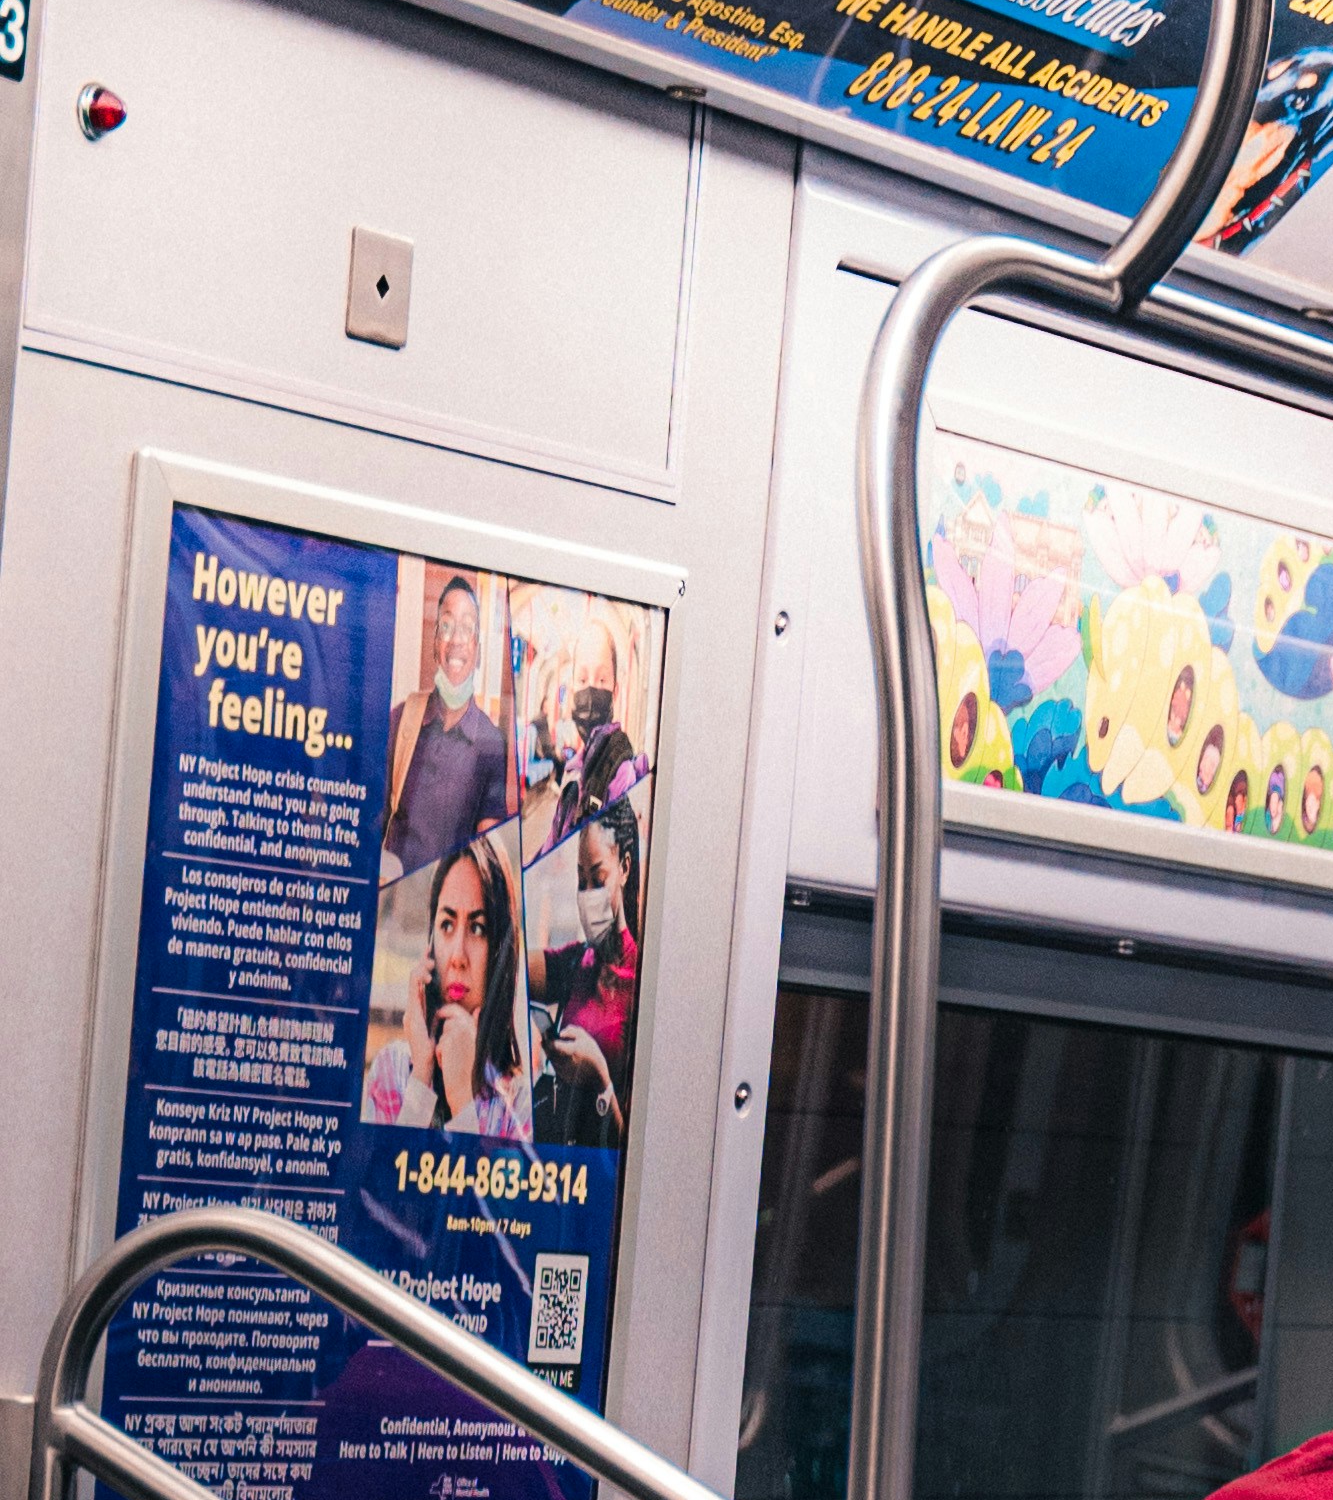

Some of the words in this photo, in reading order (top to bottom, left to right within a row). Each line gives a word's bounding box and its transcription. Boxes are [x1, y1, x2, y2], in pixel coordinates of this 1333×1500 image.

[665, 10, 686, 31] &
[768, 20, 806, 51] Esq.
[880, 1, 994, 62] HANDLE
[979, 41, 1037, 81] ALL
[1028, 58, 1171, 128] ACCIDENTS
[193, 551, 344, 626] However
[193, 623, 303, 681] you're
[208, 677, 353, 758] feeling...
[179, 753, 197, 774] NY
[199, 756, 240, 783] Project
[242, 763, 273, 788] Hope
[275, 769, 305, 791] crisis
[307, 776, 366, 800] counselors
[183, 780, 251, 806] understand
[253, 789, 284, 811] what
[285, 798, 307, 816] you
[309, 801, 328, 817] are
[329, 802, 360, 826] going
[179, 801, 229, 830] through.
[232, 809, 275, 837] Talking
[276, 818, 290, 835] to
[292, 818, 321, 840] them
[323, 823, 332, 842] is
[334, 824, 360, 848] free,
[184, 829, 258, 856] confidential,
[260, 839, 283, 858] and
[284, 843, 352, 868] anonymous.
[182, 865, 203, 886] Los
[204, 869, 267, 895] consejeros
[269, 877, 284, 896] de
[285, 880, 315, 900] crisis
[317, 883, 331, 902] de
[333, 885, 350, 905] NY
[164, 886, 207, 913] Project
[209, 893, 240, 917] Hope
[242, 898, 300, 922] entienden
[302, 904, 313, 924] lo
[315, 909, 336, 930] que
[338, 910, 362, 930] está
[171, 913, 225, 936] viviendo.
[227, 919, 263, 941] Puede
[265, 923, 302, 946] hablar
[304, 934, 324, 949] con
[326, 932, 353, 952] ellos
[167, 935, 183, 955] de
[185, 940, 231, 961] manera
[232, 946, 283, 968] gratuita,
[285, 951, 353, 975] confidencial
[228, 969, 237, 990] y
[238, 968, 292, 991] anónima.
[156, 1098, 206, 1123] Konseye
[208, 1103, 231, 1122] Kriz
[233, 1106, 250, 1123] NY
[252, 1106, 292, 1130] Project
[294, 1110, 323, 1133] Hope
[325, 1115, 339, 1134] yo
[149, 1120, 207, 1146] konprann
[209, 1130, 222, 1145] sa
[225, 1131, 235, 1146] w
[237, 1132, 252, 1151] ap
[254, 1133, 283, 1152] pase.
[286, 1132, 310, 1153] Pale
[312, 1135, 326, 1153] ak
[327, 1138, 341, 1158] yo
[156, 1148, 194, 1169] gratis,
[275, 1159, 283, 1172] e
[285, 1157, 330, 1177] anonim.
[394, 1149, 588, 1205] 1-844-863-9314
[142, 1191, 161, 1210] NY
[163, 1193, 204, 1211] Project
[446, 1214, 495, 1237] 8am-10pm
[510, 1218, 532, 1238] days
[156, 1279, 224, 1301] Кризисные
[226, 1283, 310, 1305] консультанты
[398, 1270, 458, 1305] Project
[460, 1273, 502, 1310] Hope
[132, 1301, 150, 1320] NY
[152, 1302, 193, 1326] Project
[195, 1305, 225, 1326] Hope
[228, 1310, 293, 1328] понимают,
[295, 1312, 329, 1331] через
[138, 1328, 159, 1345] что
[161, 1329, 179, 1345] вы
[182, 1330, 249, 1350] проходите.
[251, 1330, 320, 1353] Поговорите
[137, 1348, 203, 1371] бесплатно,
[205, 1351, 317, 1374] конфиденциально
[188, 1377, 197, 1392] и
[199, 1378, 263, 1395] анонимно.
[124, 1413, 141, 1432] NY
[380, 1416, 451, 1439] Confidential,
[453, 1418, 516, 1441] Anonymous
[339, 1440, 366, 1459] Here
[369, 1442, 381, 1459] to
[383, 1441, 408, 1461] Talk
[417, 1442, 444, 1461] Here
[446, 1444, 458, 1461] to
[460, 1442, 493, 1461] Listen
[502, 1442, 527, 1461] Here
[529, 1445, 541, 1461] to
